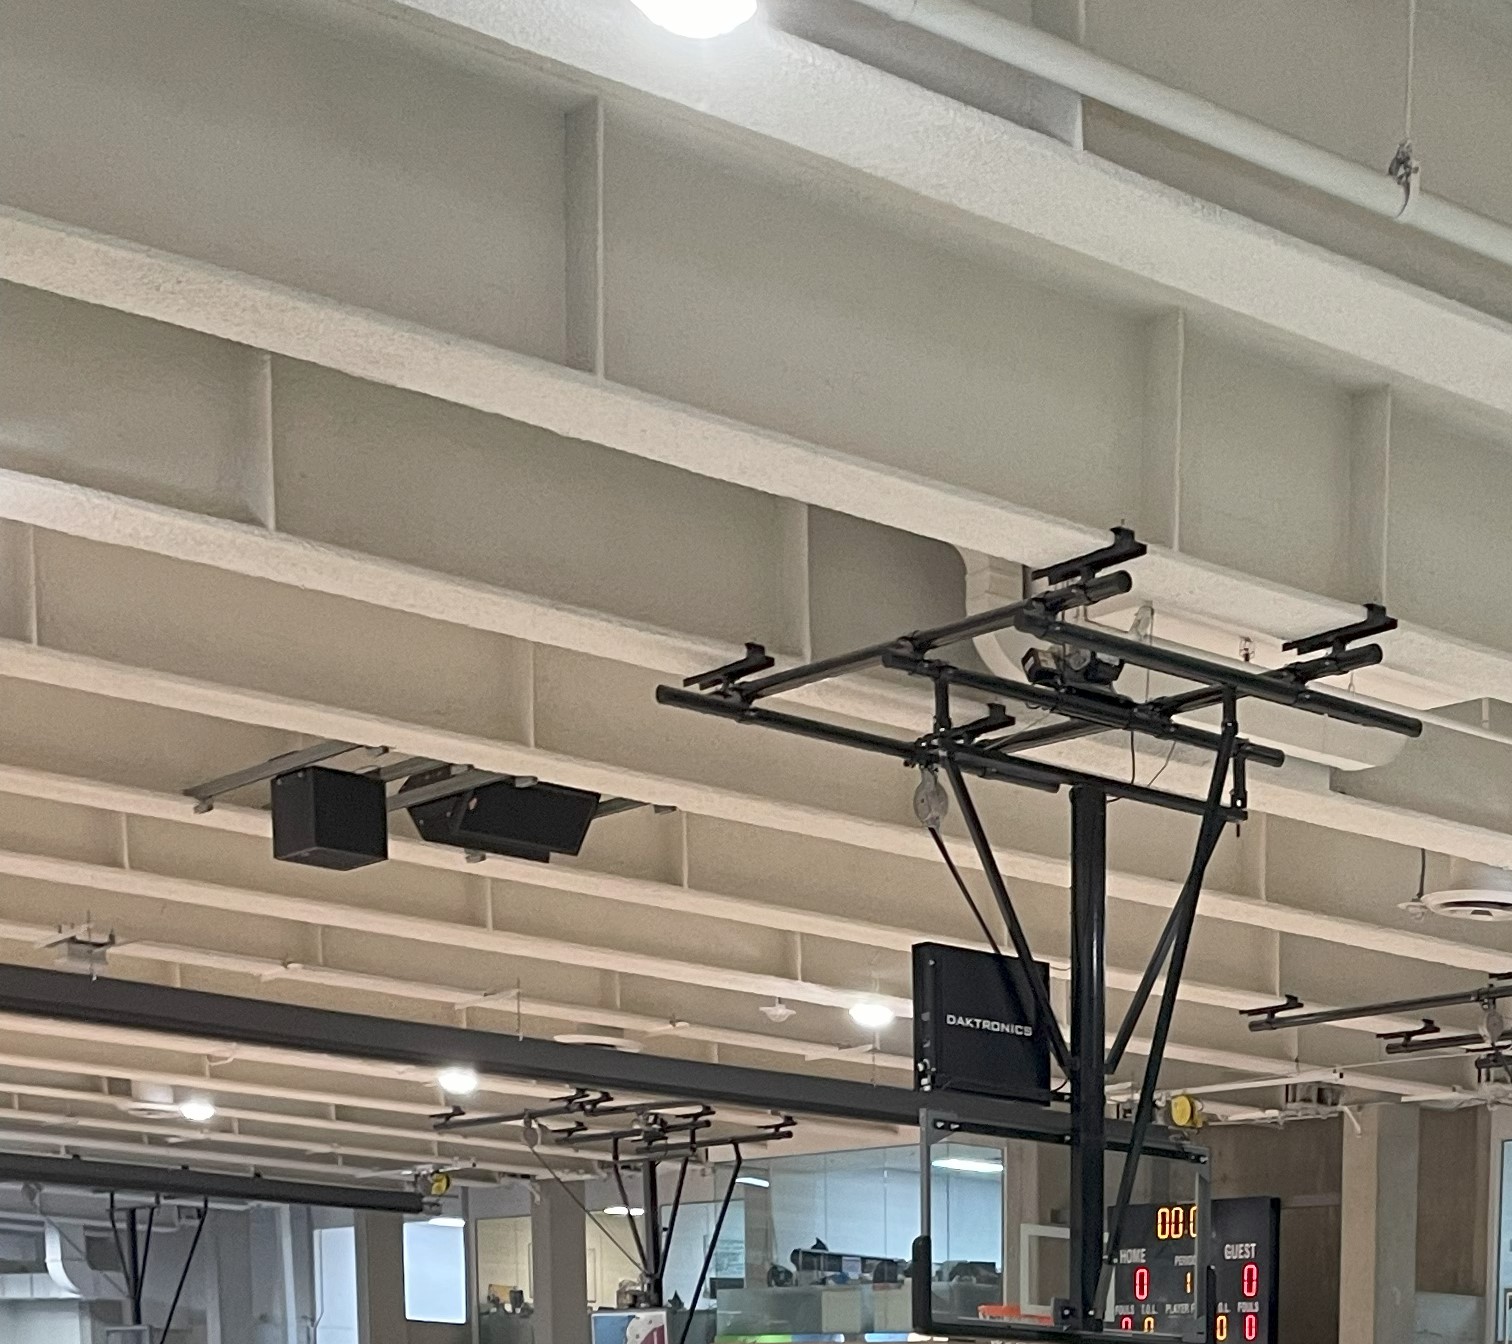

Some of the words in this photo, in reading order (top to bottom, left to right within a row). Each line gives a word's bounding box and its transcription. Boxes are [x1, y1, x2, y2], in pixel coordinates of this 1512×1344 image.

[946, 1014, 1033, 1037] DAKTRONICS
[1119, 1248, 1146, 1264] HOME
[1174, 1255, 1196, 1266] PERIO
[1224, 1243, 1256, 1260] GUEST
[1135, 1268, 1148, 1300] 0
[1243, 1264, 1258, 1297] 0
[1237, 1301, 1259, 1313] FOULS
[1216, 1315, 1227, 1341] 0
[1245, 1314, 1256, 1341] 0
